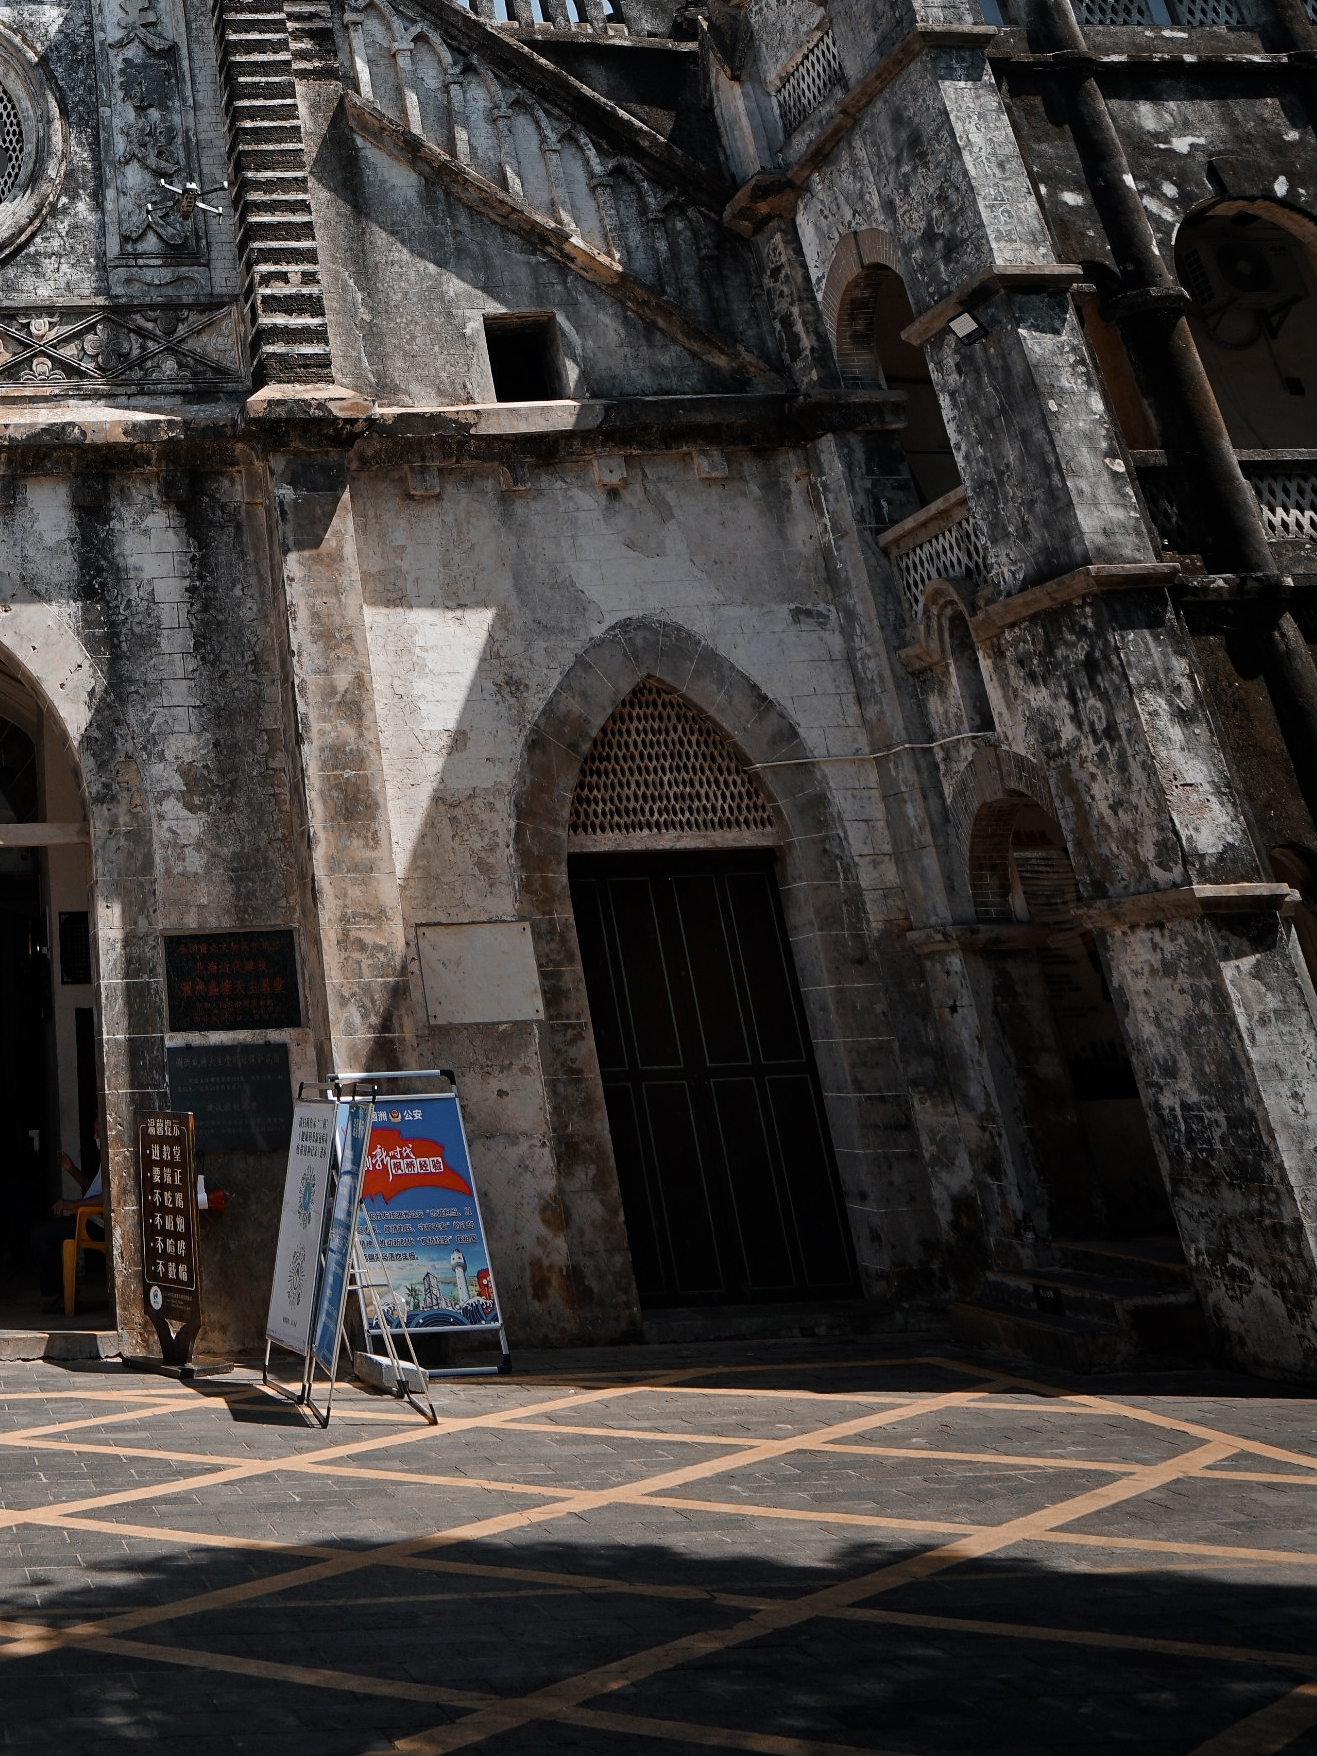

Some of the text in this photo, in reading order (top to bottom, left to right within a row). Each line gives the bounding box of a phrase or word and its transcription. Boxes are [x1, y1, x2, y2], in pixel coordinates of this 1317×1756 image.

[403, 1109, 423, 1120] 公安
[147, 1118, 180, 1137] 温馨提示
[392, 1157, 444, 1174] 枫桥经验
